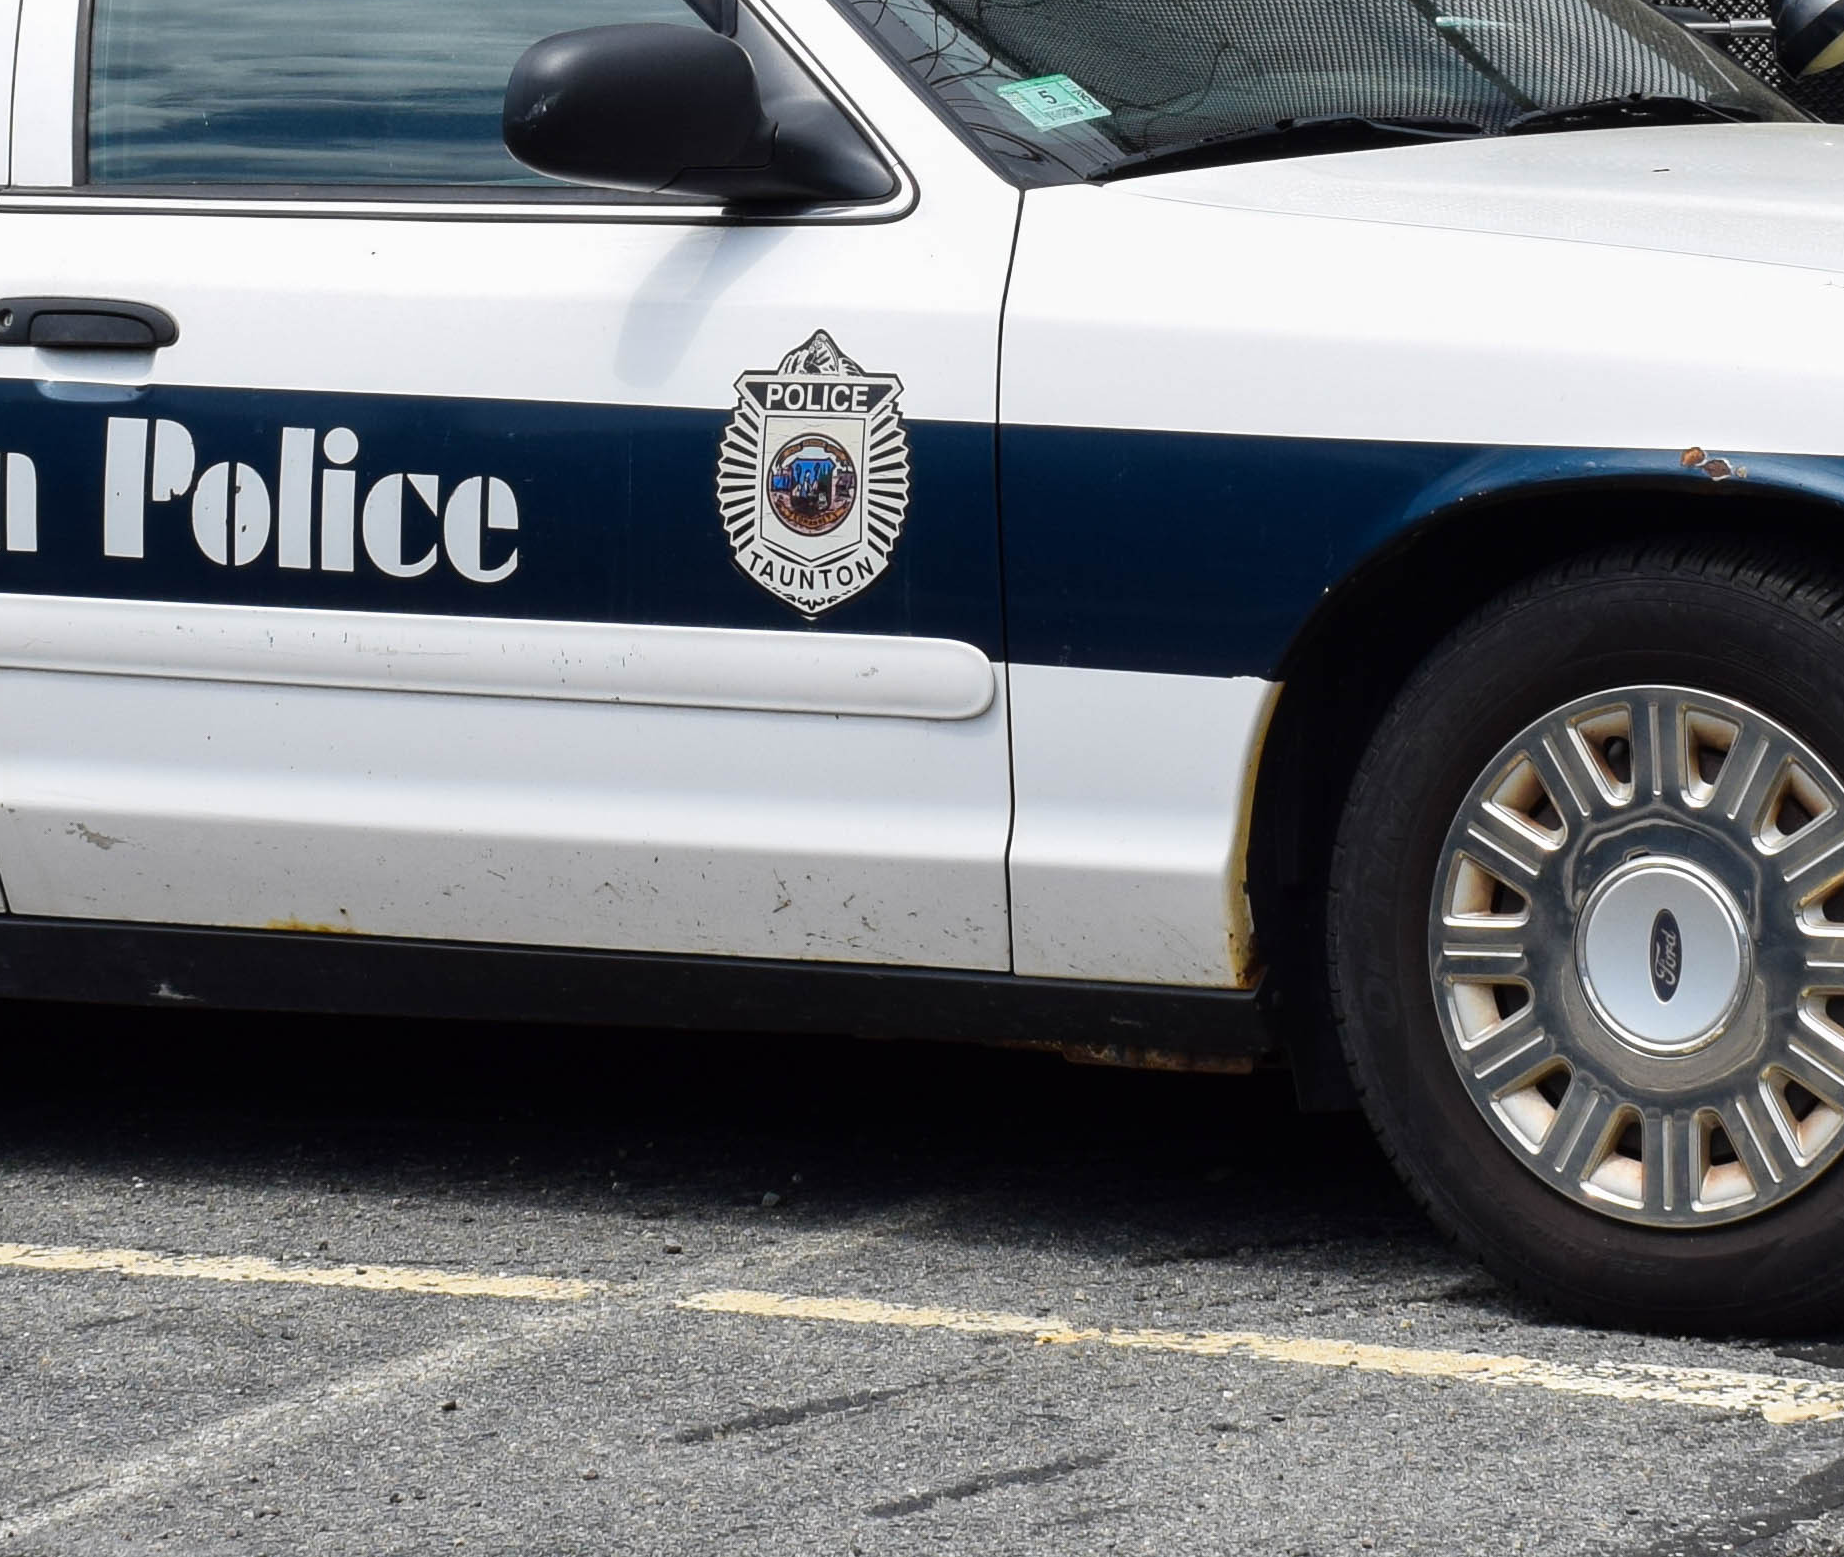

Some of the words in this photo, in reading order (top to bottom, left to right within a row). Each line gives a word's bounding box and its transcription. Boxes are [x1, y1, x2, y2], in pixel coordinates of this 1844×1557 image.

[1038, 90, 1058, 104] 5
[765, 383, 869, 412] POLICE
[104, 416, 519, 584] Police
[748, 550, 875, 591] TAUNTON
[1656, 928, 1678, 986] Ford
